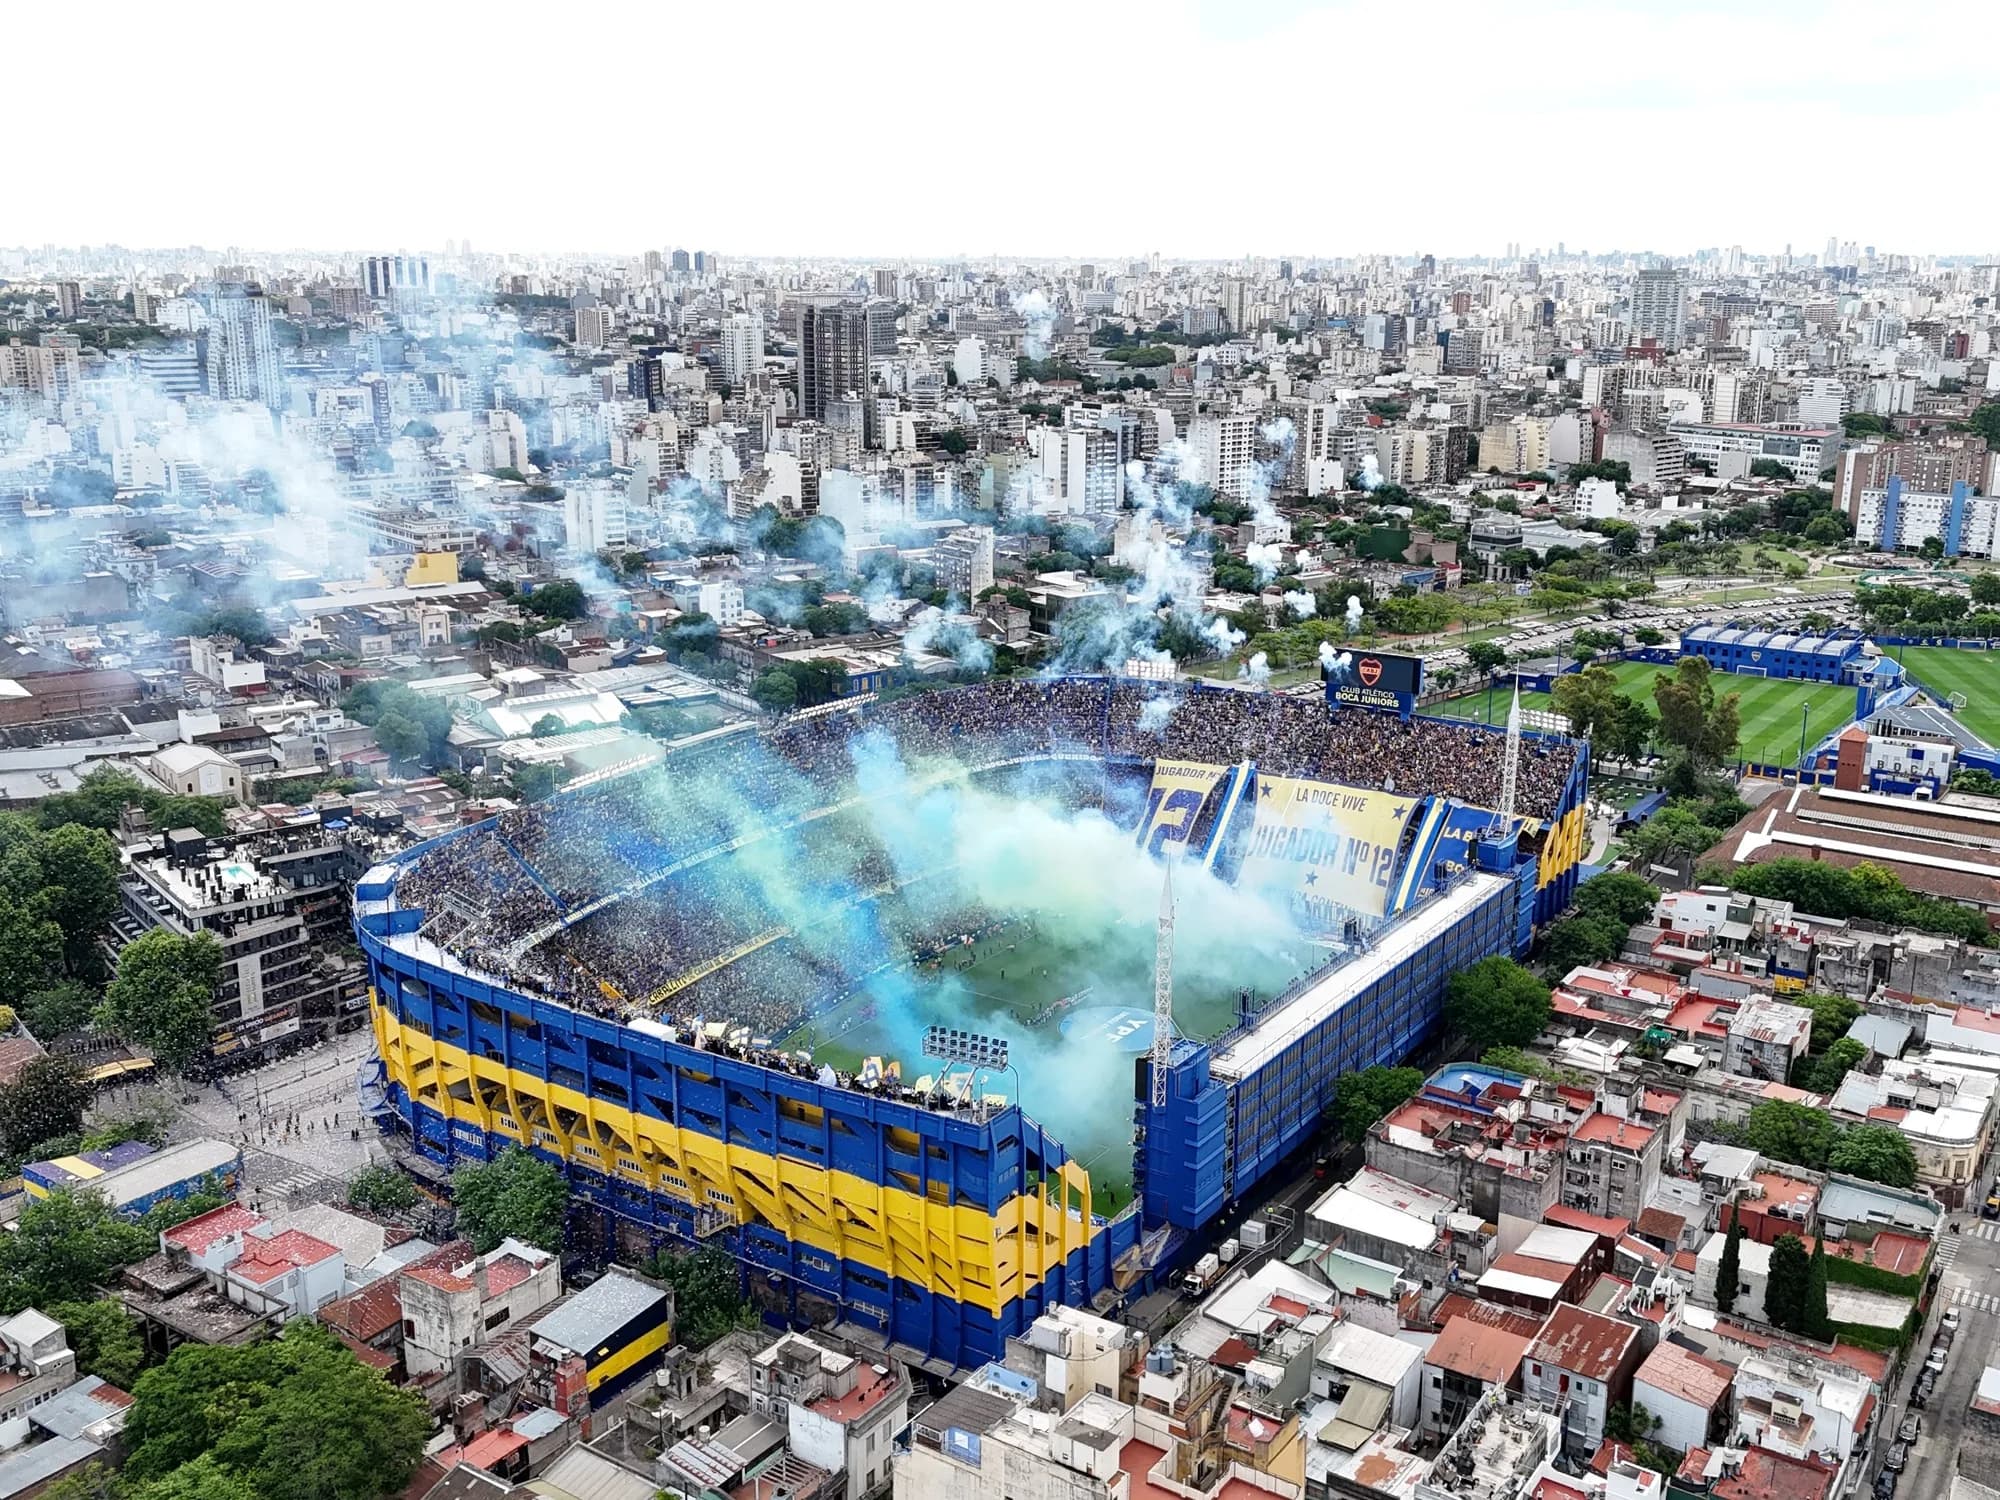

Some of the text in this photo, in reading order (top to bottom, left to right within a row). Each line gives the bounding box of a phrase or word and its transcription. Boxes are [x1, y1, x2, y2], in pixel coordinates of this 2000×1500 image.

[1335, 691, 1399, 707] BOCA JUNIORS
[1340, 685, 1395, 699] CLUB ATLÉTICO
[1156, 766, 1206, 779] JUGADOR
[1877, 760, 1935, 777] BOCA
[1296, 787, 1369, 812] LA DOCE VIVE
[1136, 787, 1204, 858] 12
[1443, 826, 1461, 839] LA
[1248, 825, 1340, 866] JUGADOR
[1369, 845, 1395, 888] 12
[648, 974, 689, 1004] CABALLITO
[1105, 1019, 1148, 1043] YPF
